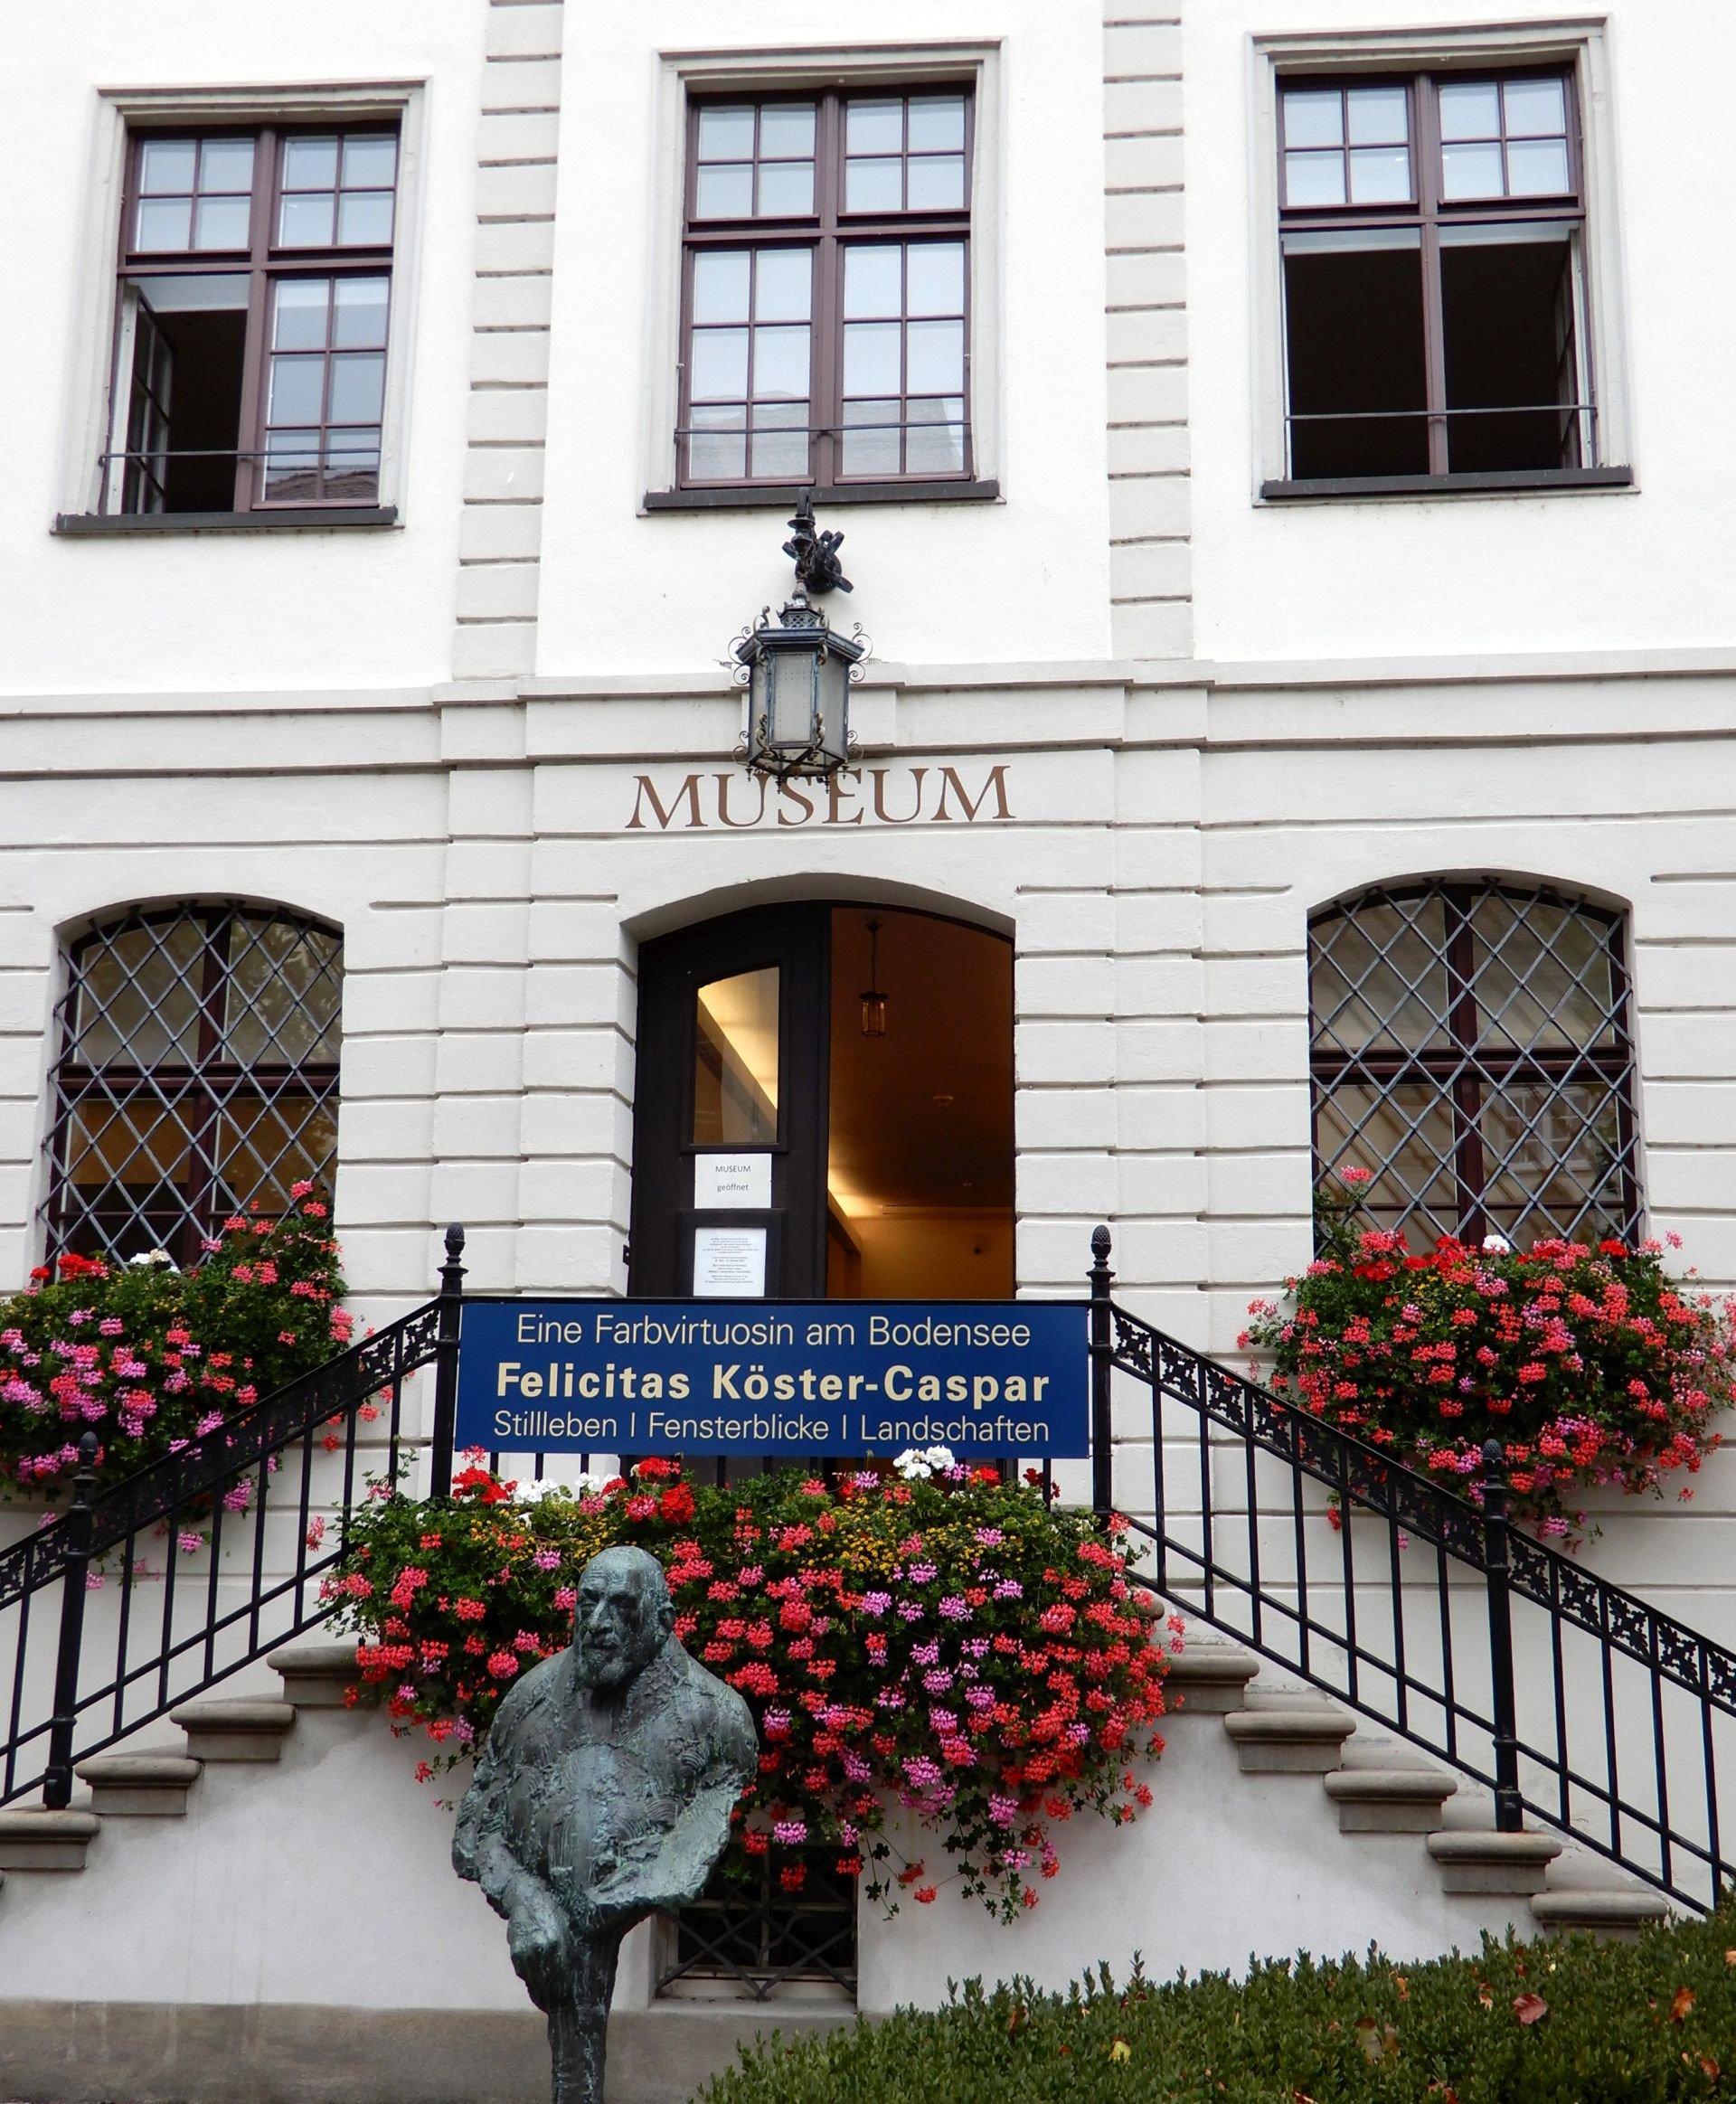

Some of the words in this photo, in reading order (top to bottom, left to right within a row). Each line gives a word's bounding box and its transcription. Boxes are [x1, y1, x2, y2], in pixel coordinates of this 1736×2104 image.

[625, 766, 1016, 829] MUSEUM
[715, 1165, 751, 1174] MUSEUM
[717, 1183, 749, 1193] geöffnet
[517, 1314, 582, 1344] Eine
[596, 1314, 794, 1345] Farbvirtuosin
[806, 1324, 854, 1346] am
[870, 1316, 1031, 1346] Bodensee
[497, 1363, 690, 1400] Felicitas
[712, 1363, 1050, 1411] Köster-Caspar
[494, 1410, 617, 1438] Stillleben
[649, 1411, 829, 1440] Fensterblicke
[861, 1414, 1049, 1442] Landschaften
